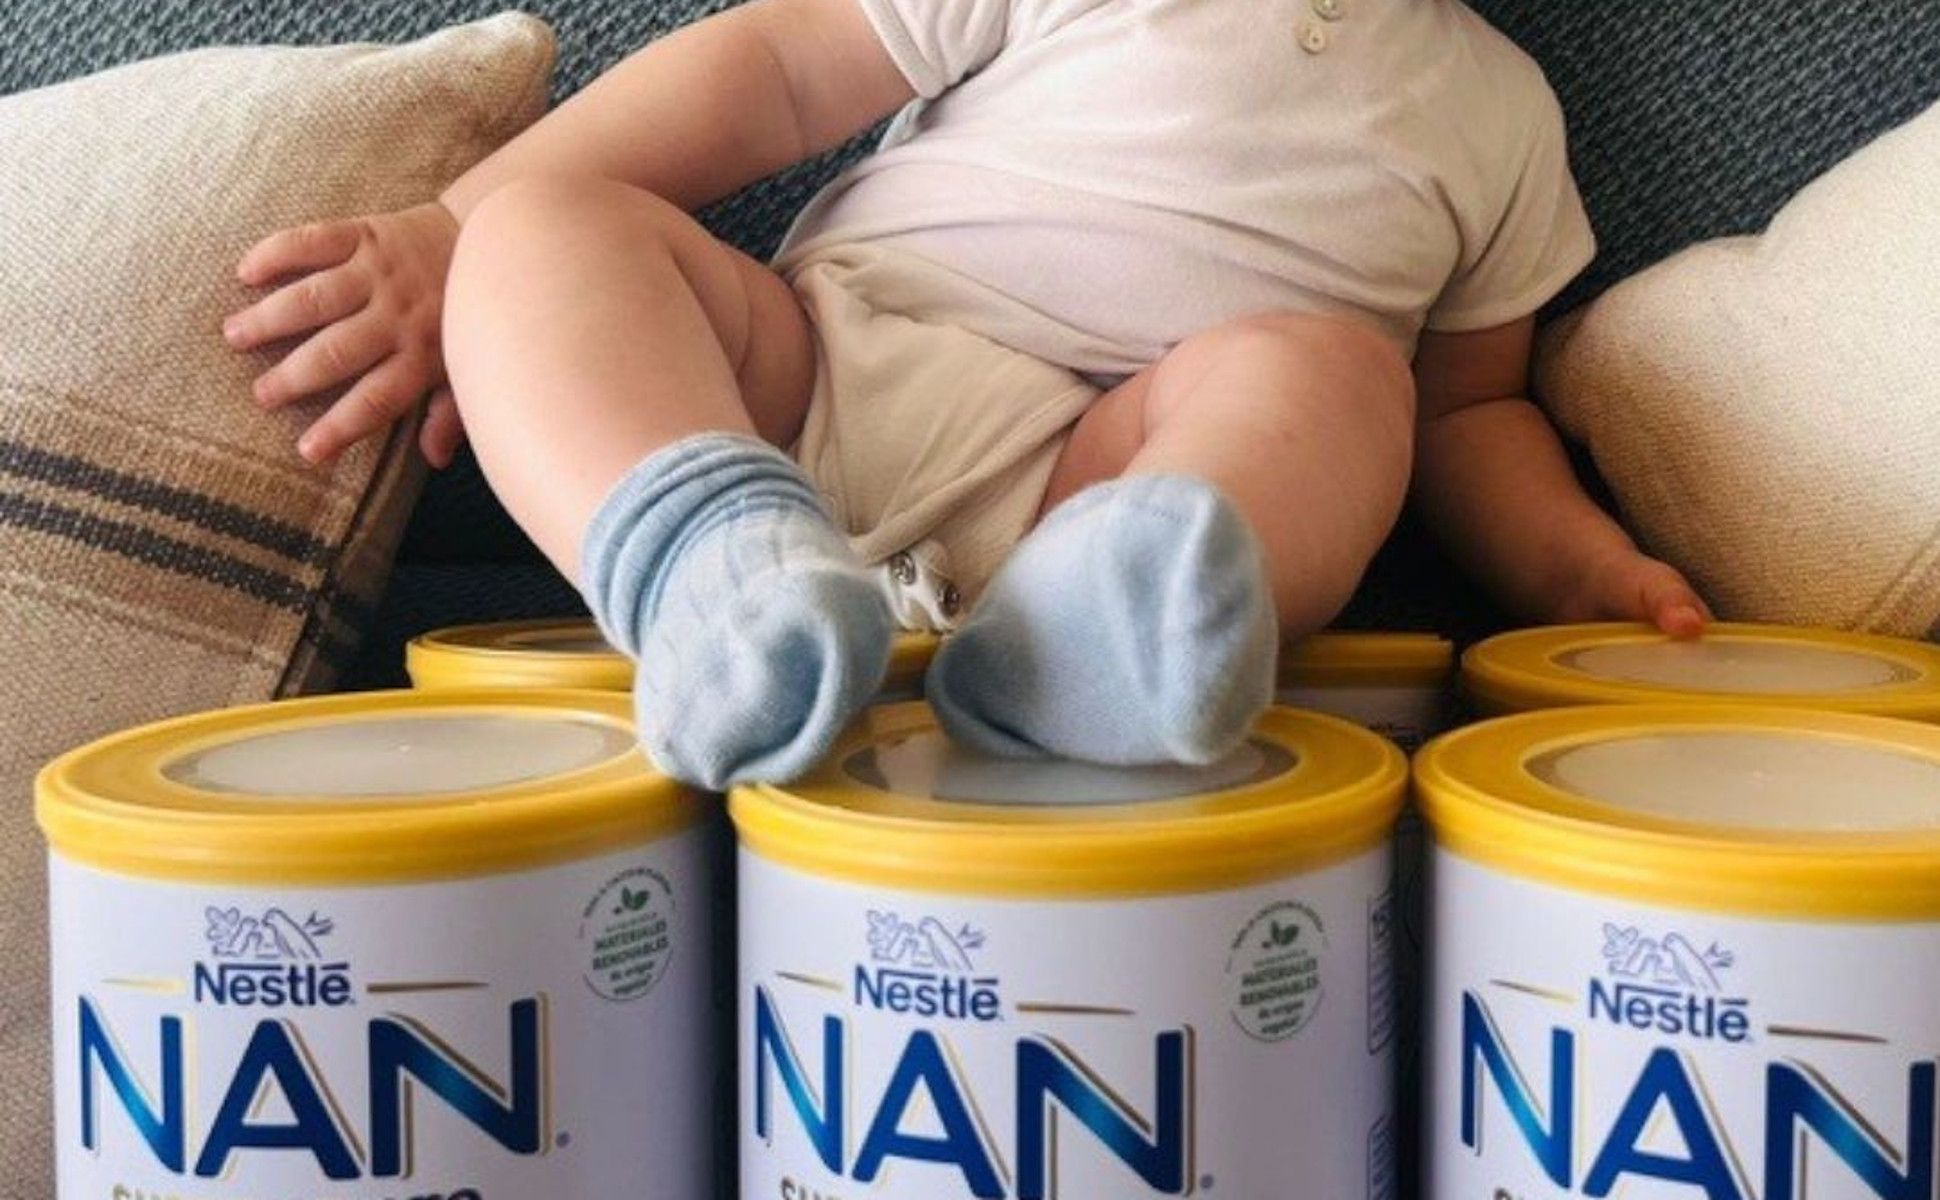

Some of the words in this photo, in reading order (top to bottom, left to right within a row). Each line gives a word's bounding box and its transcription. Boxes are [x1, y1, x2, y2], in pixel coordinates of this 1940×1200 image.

[194, 961, 351, 1007] Nestlé
[854, 964, 1000, 1022] Nestlé
[1588, 977, 1751, 1043] Nestlé
[78, 994, 549, 1180] NAN
[755, 983, 1196, 1200] NAN
[1460, 989, 1940, 1200] NAN
